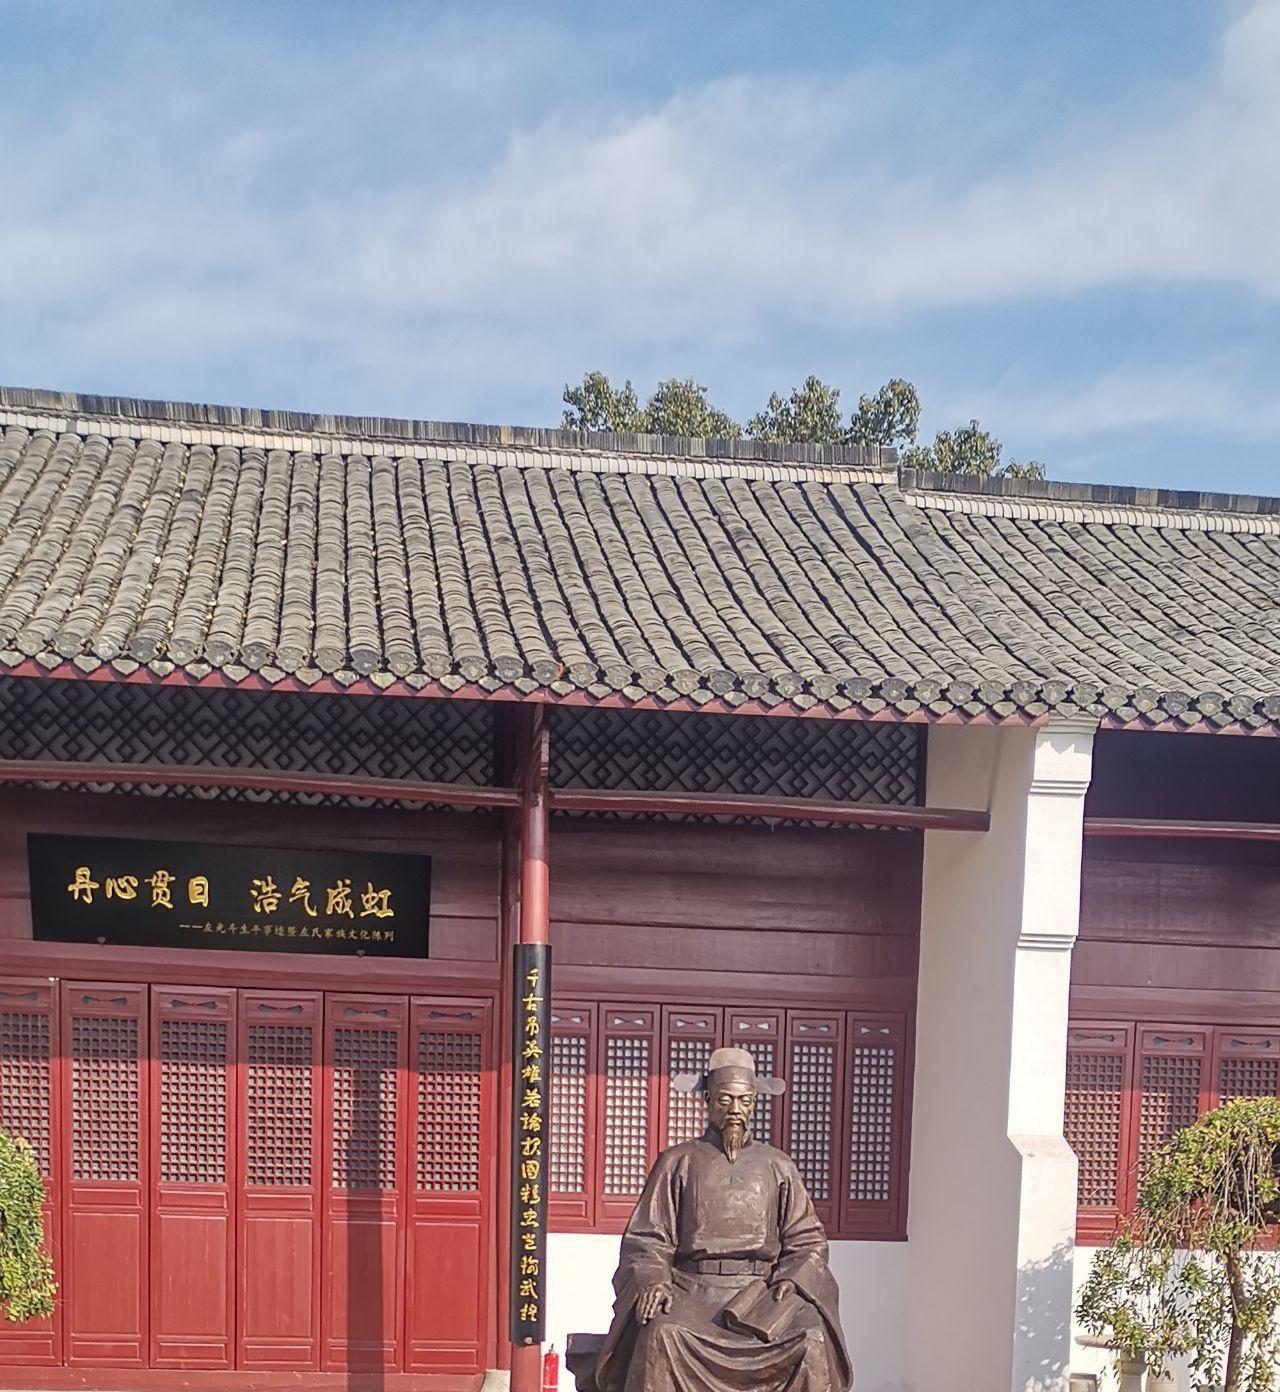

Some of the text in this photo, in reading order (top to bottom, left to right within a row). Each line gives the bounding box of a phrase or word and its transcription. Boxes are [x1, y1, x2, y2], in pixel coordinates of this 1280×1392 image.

[68, 866, 395, 919] 丹心贯日 浩气成虹
